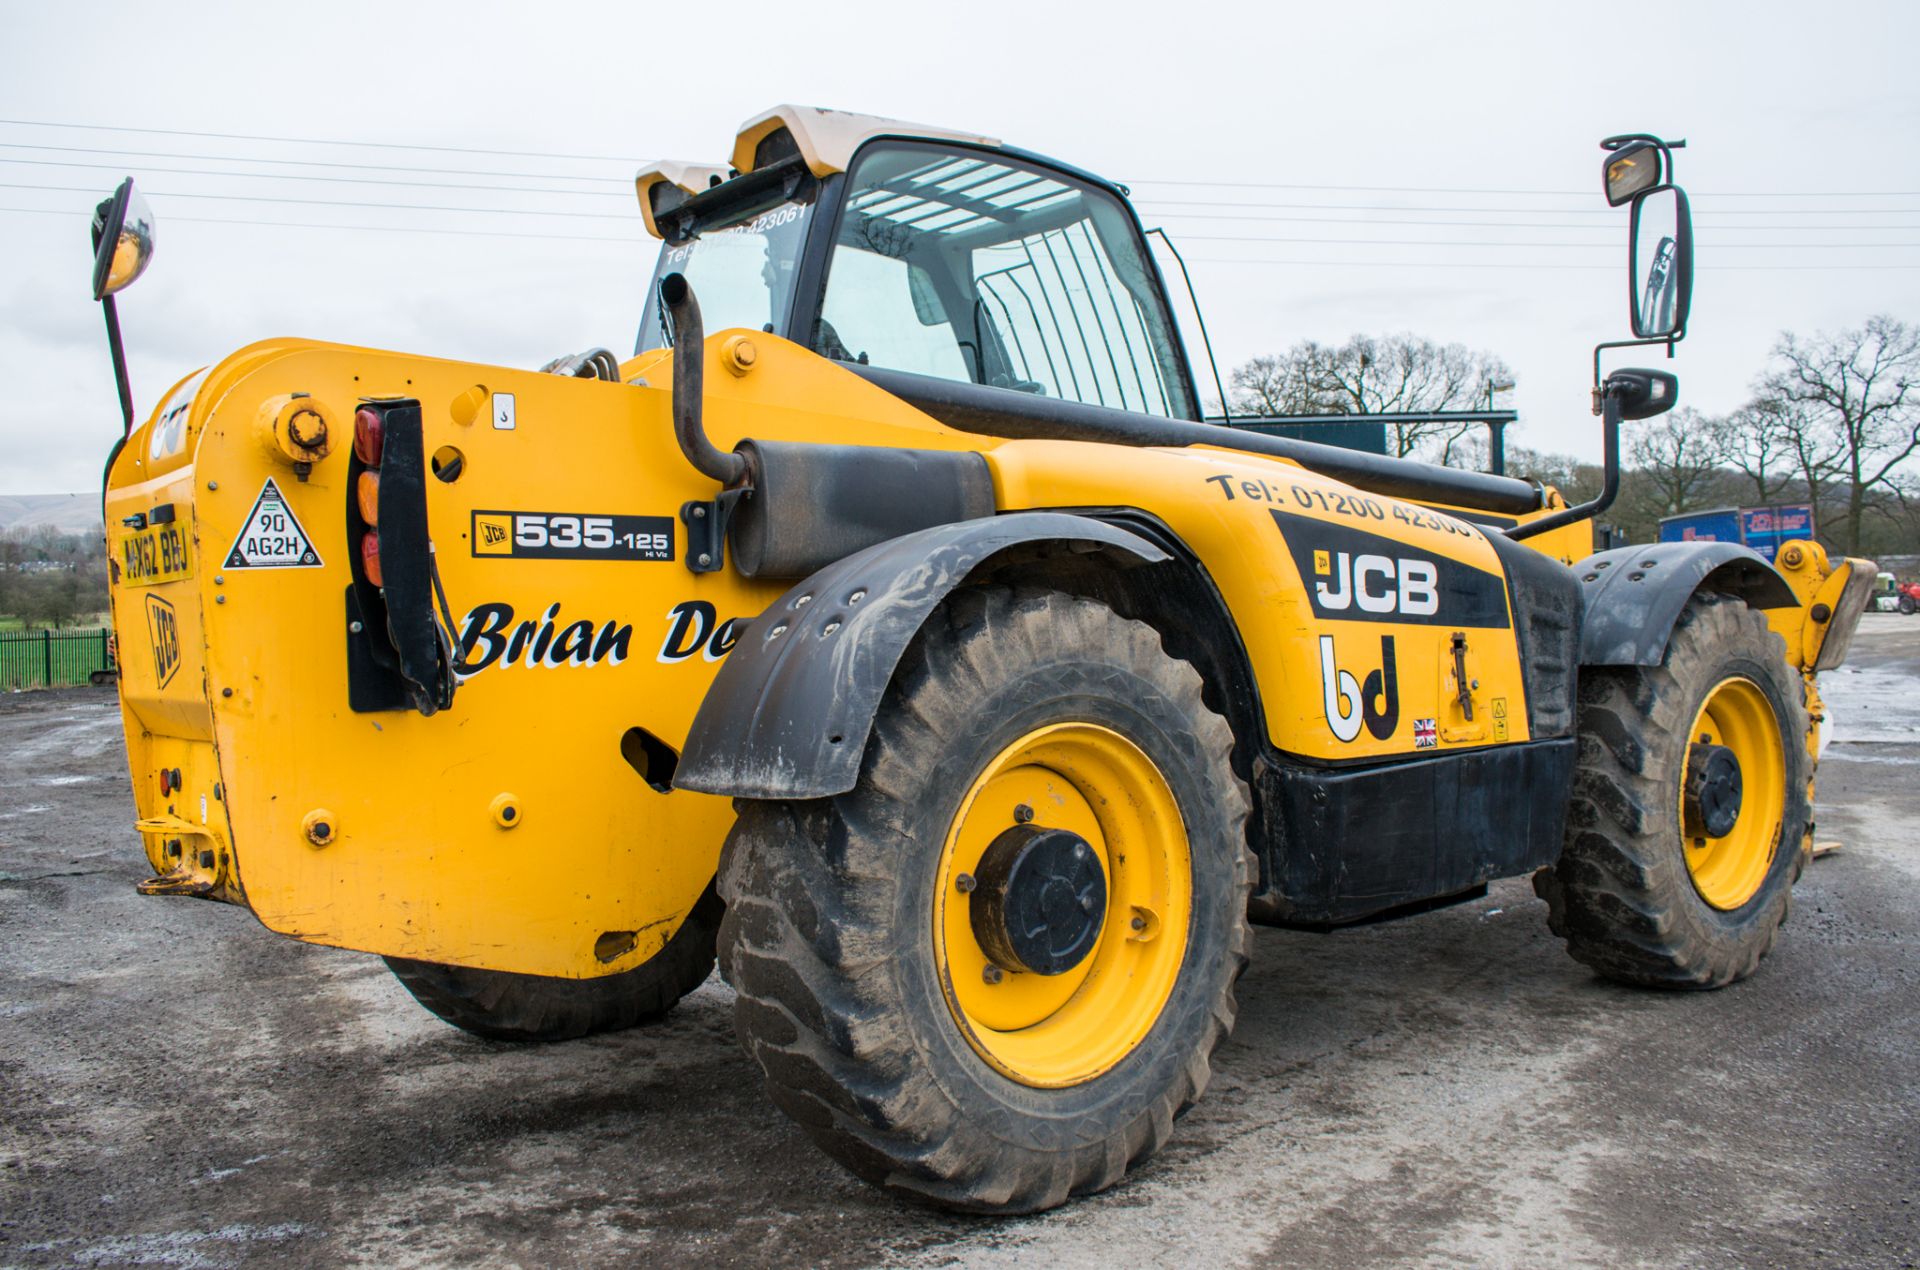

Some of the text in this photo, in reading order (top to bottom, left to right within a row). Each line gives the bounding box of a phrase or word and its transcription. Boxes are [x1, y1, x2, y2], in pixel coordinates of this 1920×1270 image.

[1205, 474, 1285, 504] Tel:
[1291, 485, 1385, 521] 01200
[247, 537, 298, 556] AG2H
[485, 524, 507, 545] JCB
[1314, 549, 1439, 616] JCB
[152, 604, 178, 680] JCB
[452, 602, 633, 681] Brian
[1319, 634, 1400, 743] bd
